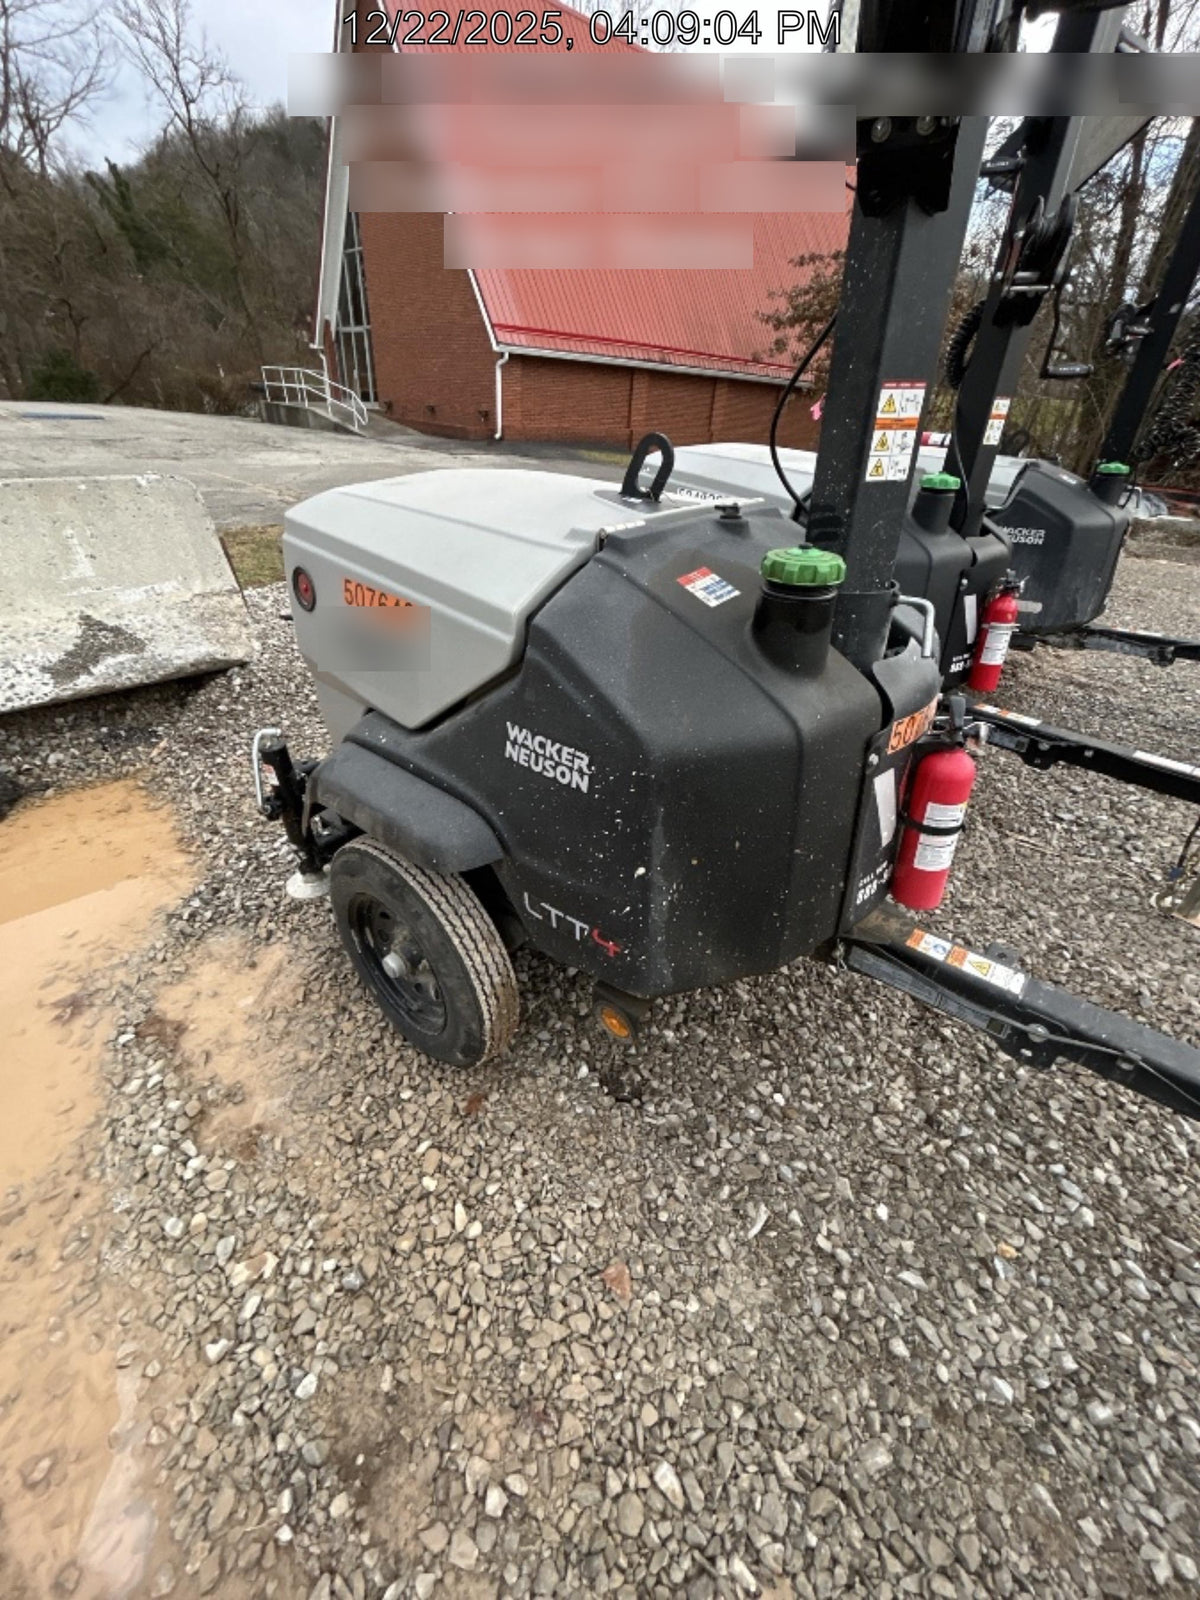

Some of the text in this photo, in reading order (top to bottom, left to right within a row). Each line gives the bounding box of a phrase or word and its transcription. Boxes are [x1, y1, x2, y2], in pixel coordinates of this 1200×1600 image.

[1003, 526, 1047, 539] ACKER
[344, 578, 413, 608] 5076
[504, 740, 590, 794] NEUSON
[505, 720, 592, 775] WACKER
